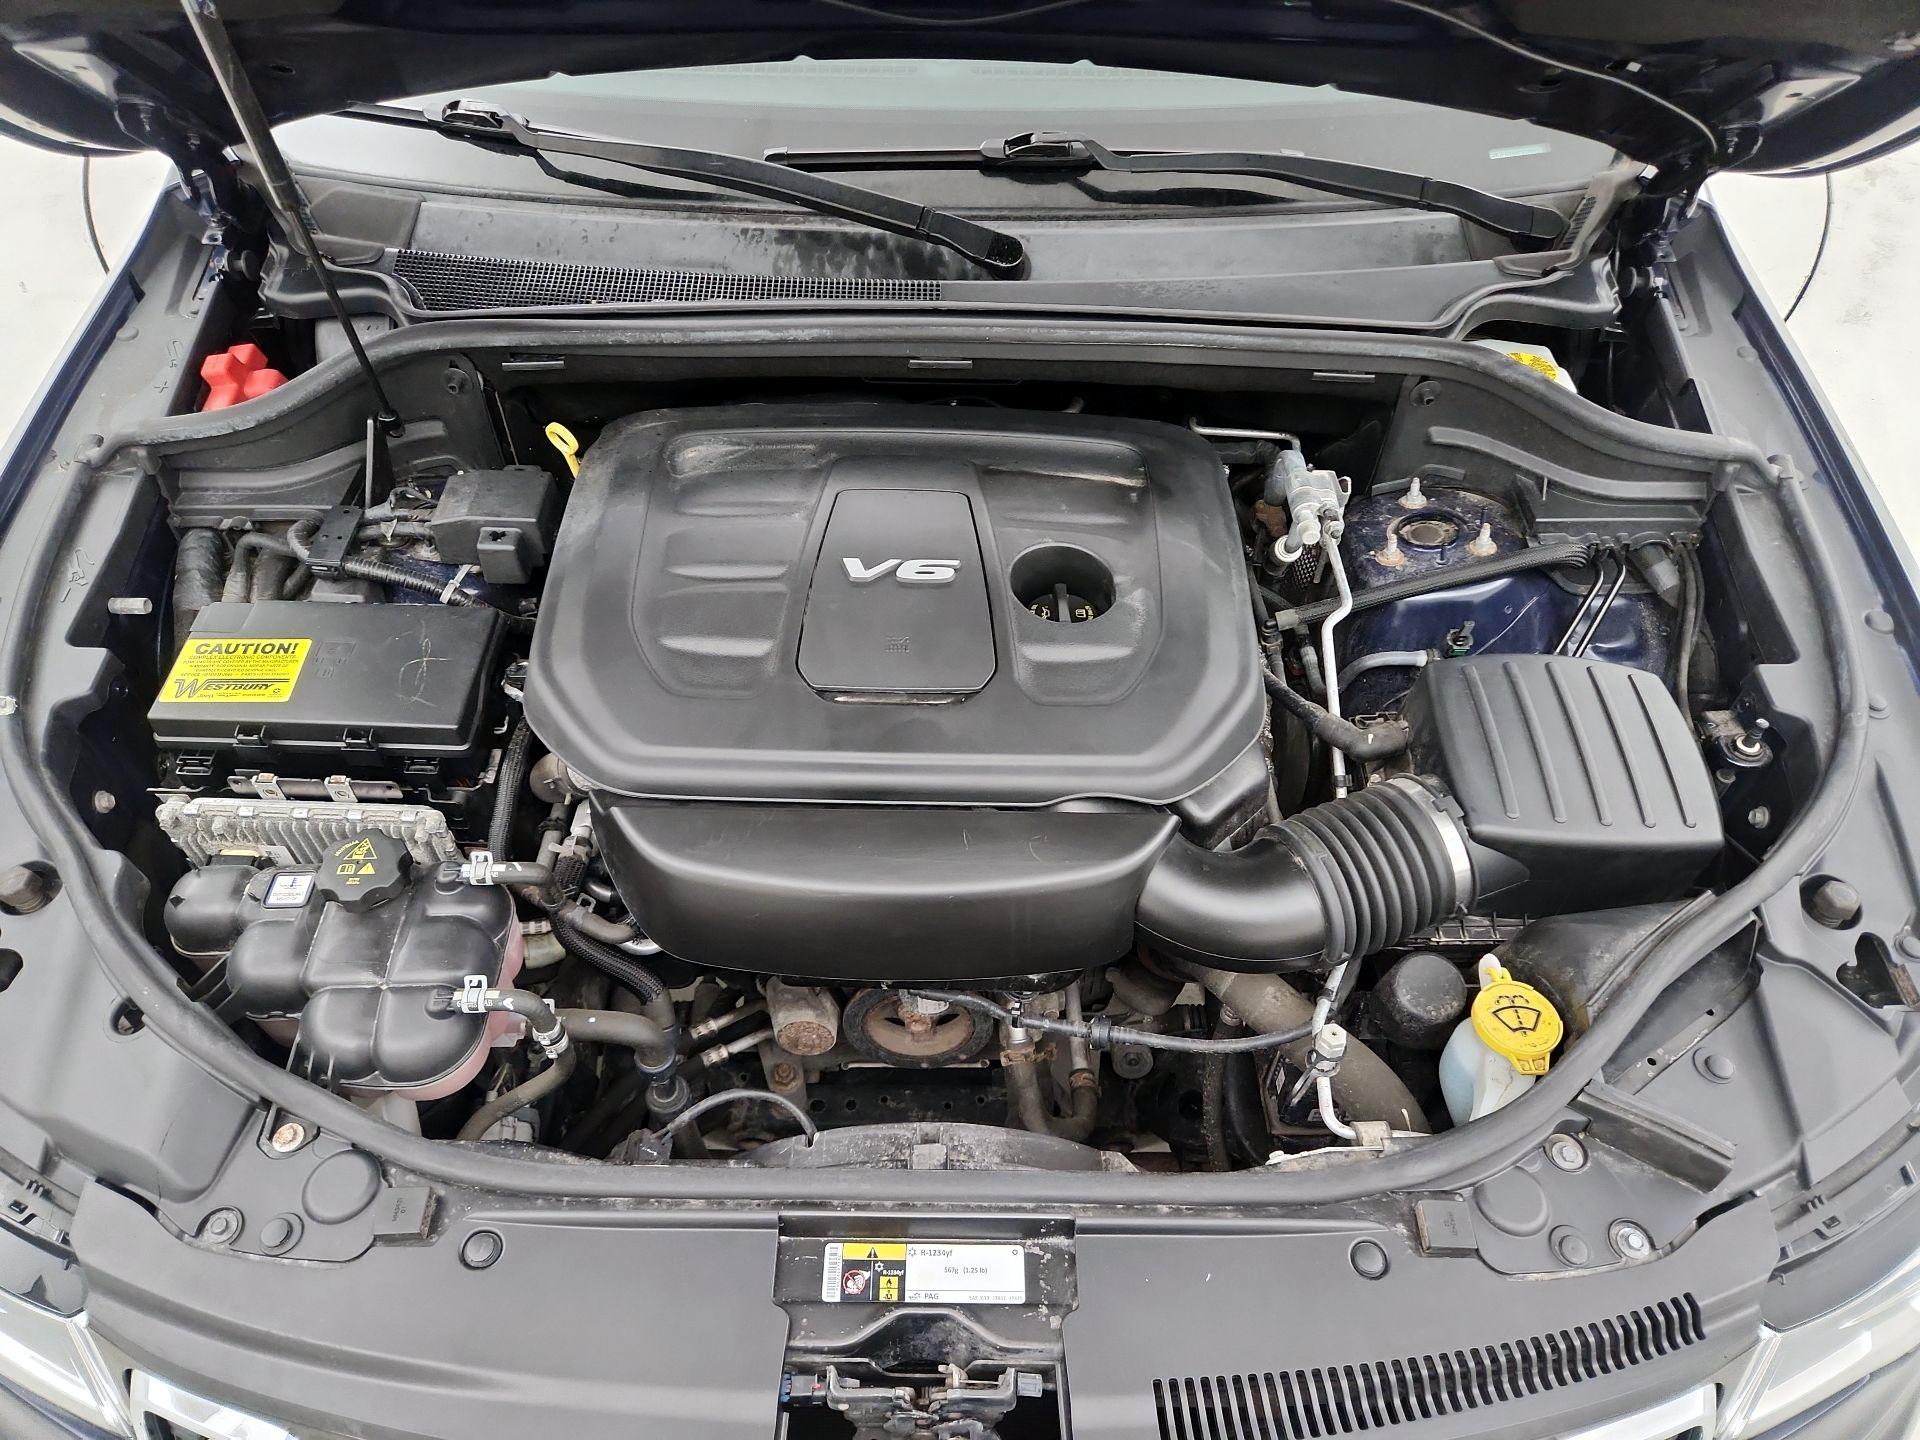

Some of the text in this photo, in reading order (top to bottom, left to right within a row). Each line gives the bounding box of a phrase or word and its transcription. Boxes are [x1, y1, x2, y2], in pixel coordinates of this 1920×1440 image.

[841, 556, 962, 585] V6
[195, 643, 299, 654] CAUTION!
[174, 678, 275, 698] WESTBURY
[920, 1248, 954, 1258] R-1234yf
[944, 1266, 988, 1275] 567g (1.25 lb)
